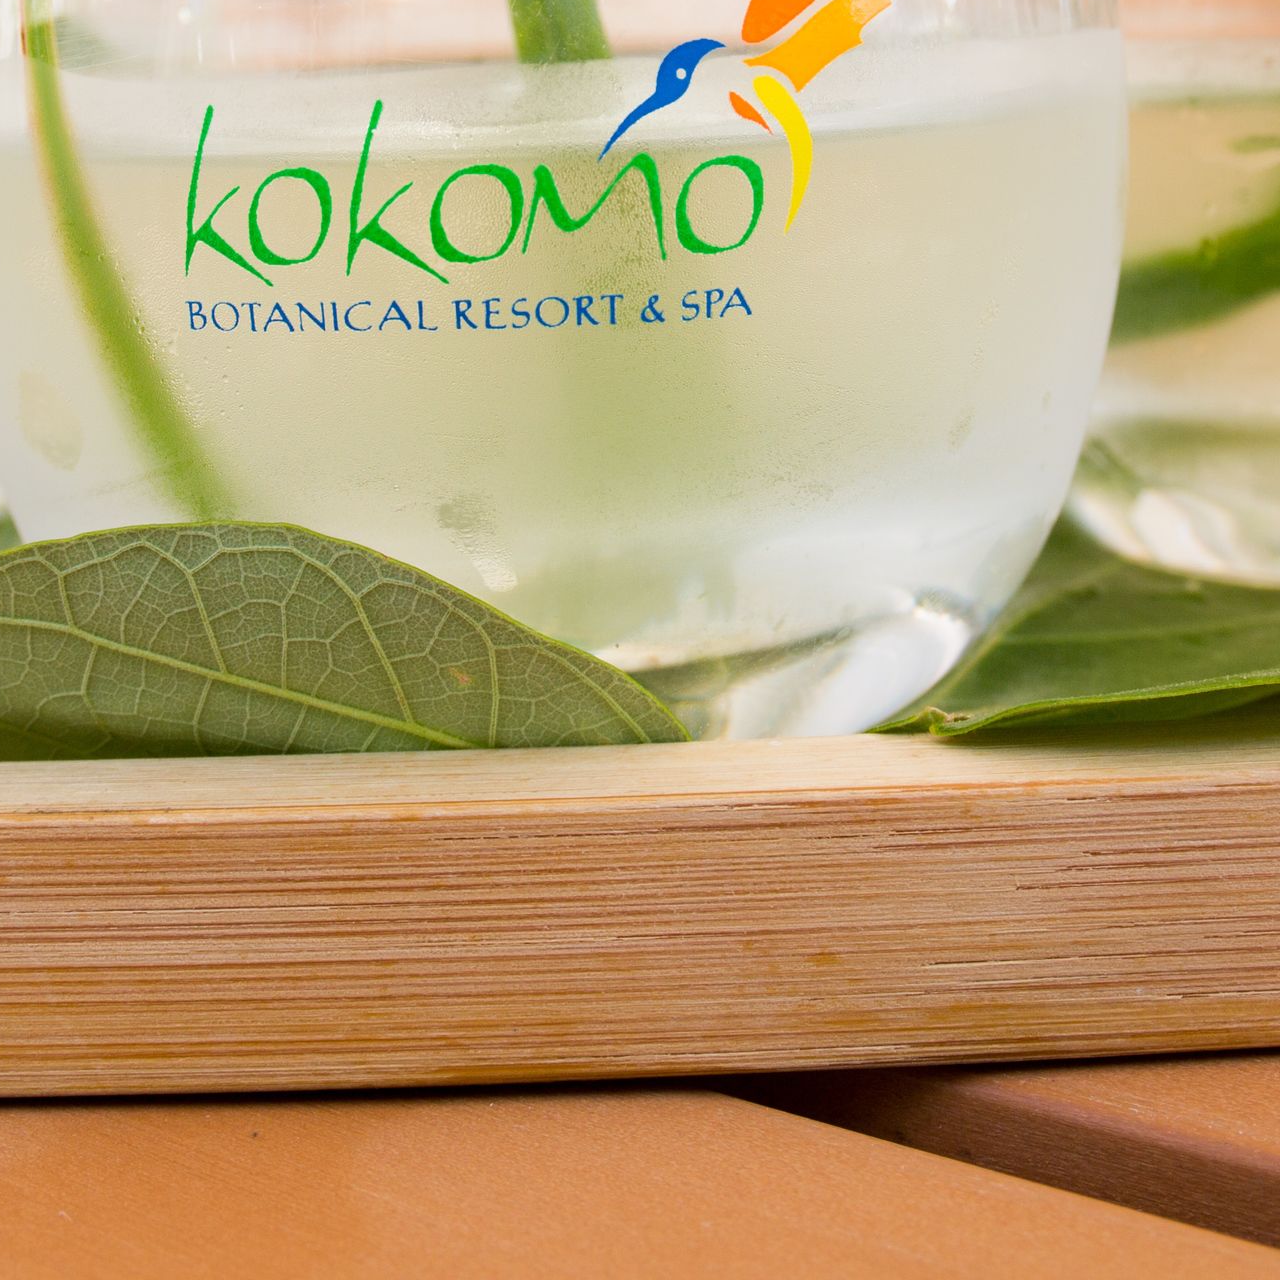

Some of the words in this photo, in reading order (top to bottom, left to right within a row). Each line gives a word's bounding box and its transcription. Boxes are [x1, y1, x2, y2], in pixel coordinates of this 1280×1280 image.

[185, 299, 439, 333] BOTANICAL
[452, 292, 625, 331] RESORT
[639, 294, 666, 324] &
[680, 287, 754, 322] SPA
